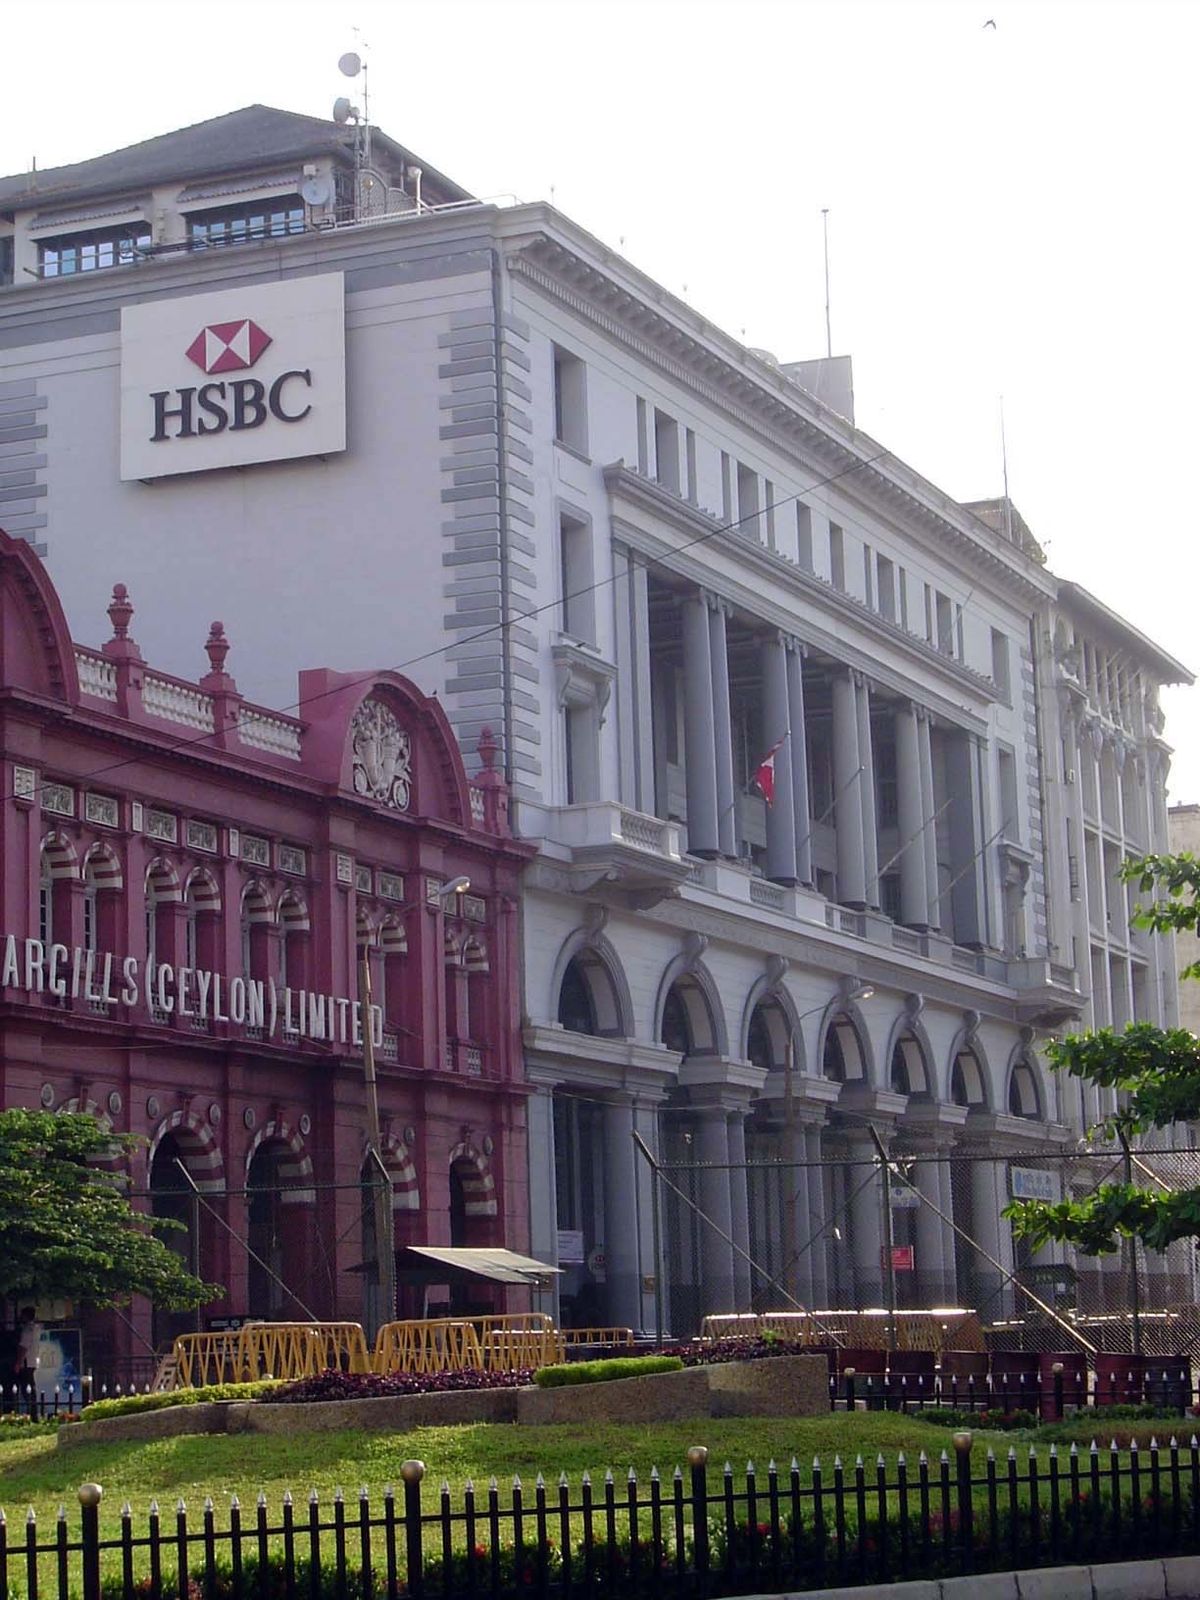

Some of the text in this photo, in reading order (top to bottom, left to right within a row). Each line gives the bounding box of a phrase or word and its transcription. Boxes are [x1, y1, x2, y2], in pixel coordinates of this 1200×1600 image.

[149, 369, 312, 442] HSBC
[145, 952, 277, 1037] (CEYLON)
[285, 987, 383, 1047] LIMITED
